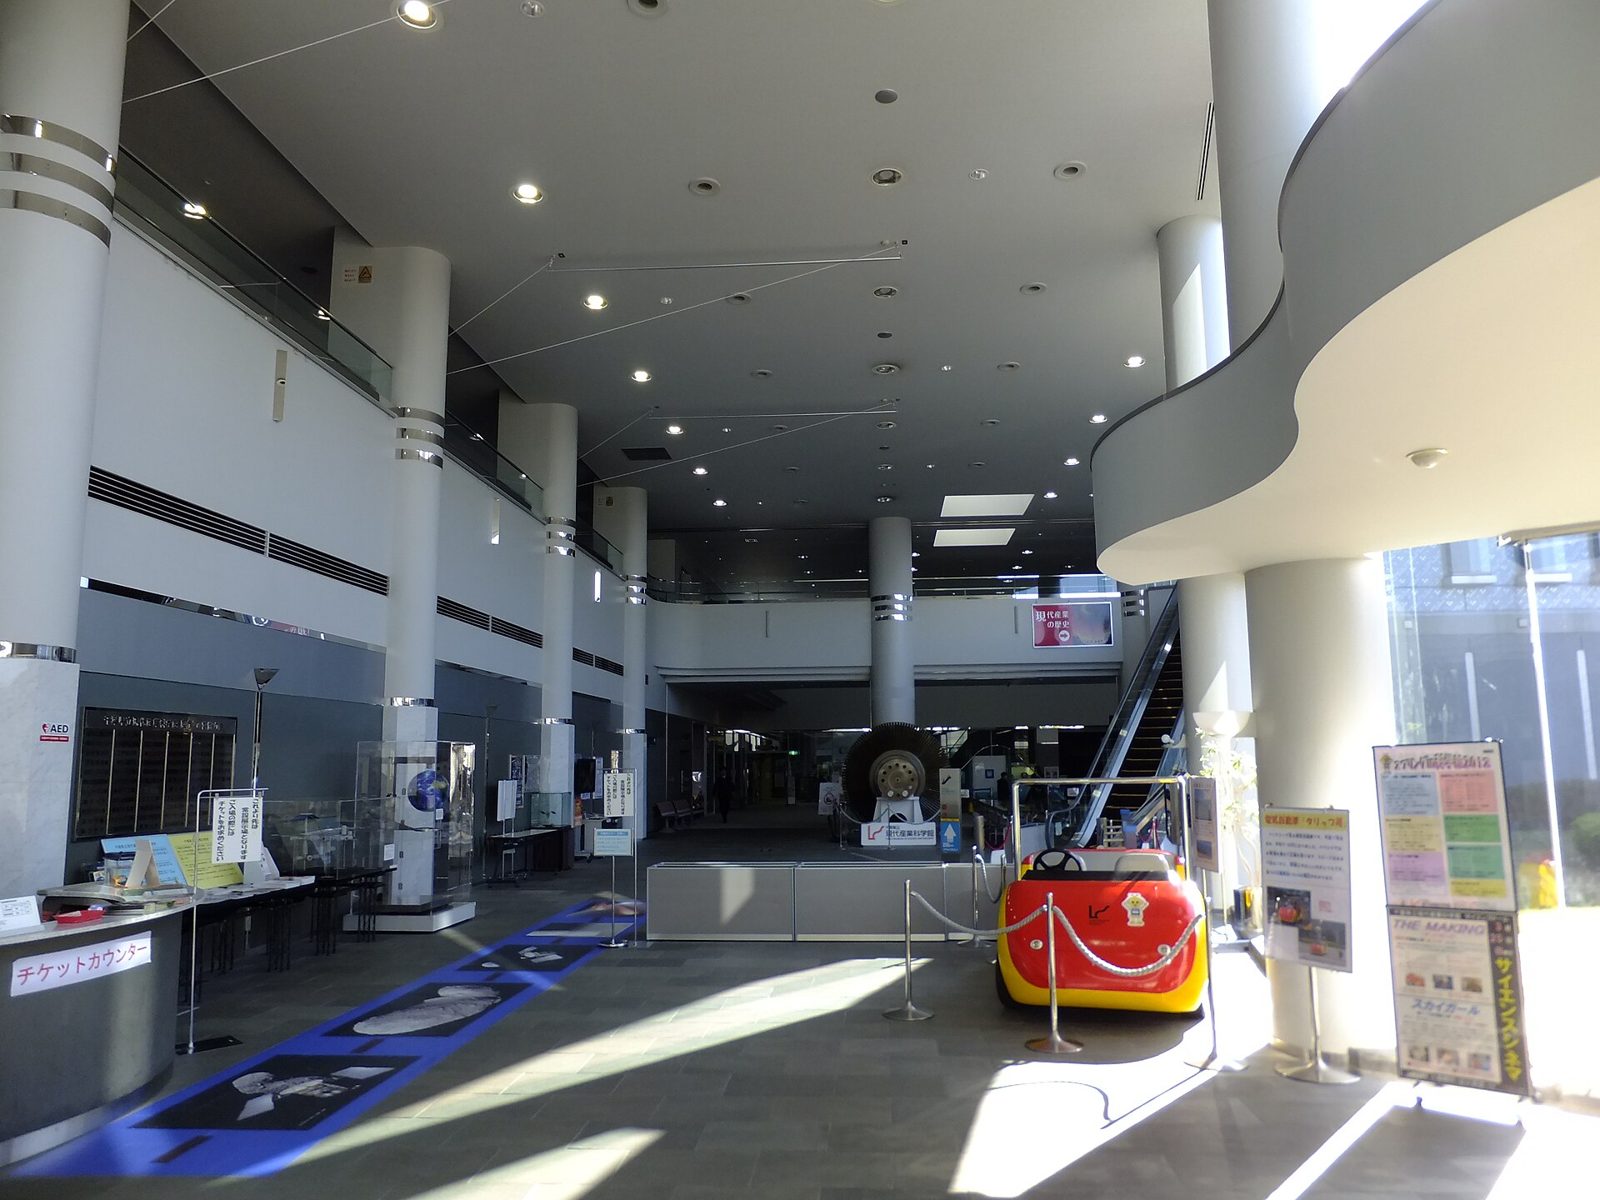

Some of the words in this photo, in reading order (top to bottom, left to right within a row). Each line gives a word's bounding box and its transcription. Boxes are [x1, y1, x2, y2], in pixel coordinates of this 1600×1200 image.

[1035, 610, 1069, 622] 現代産業
[1046, 620, 1070, 629] の歴史
[50, 724, 69, 733] AED
[1393, 919, 1421, 931] THE
[1425, 921, 1486, 935] MAKING
[16, 943, 148, 986] チケットカウンター
[1411, 998, 1480, 1015] スカイガール
[1494, 956, 1522, 1082] サイエンスシネマ
